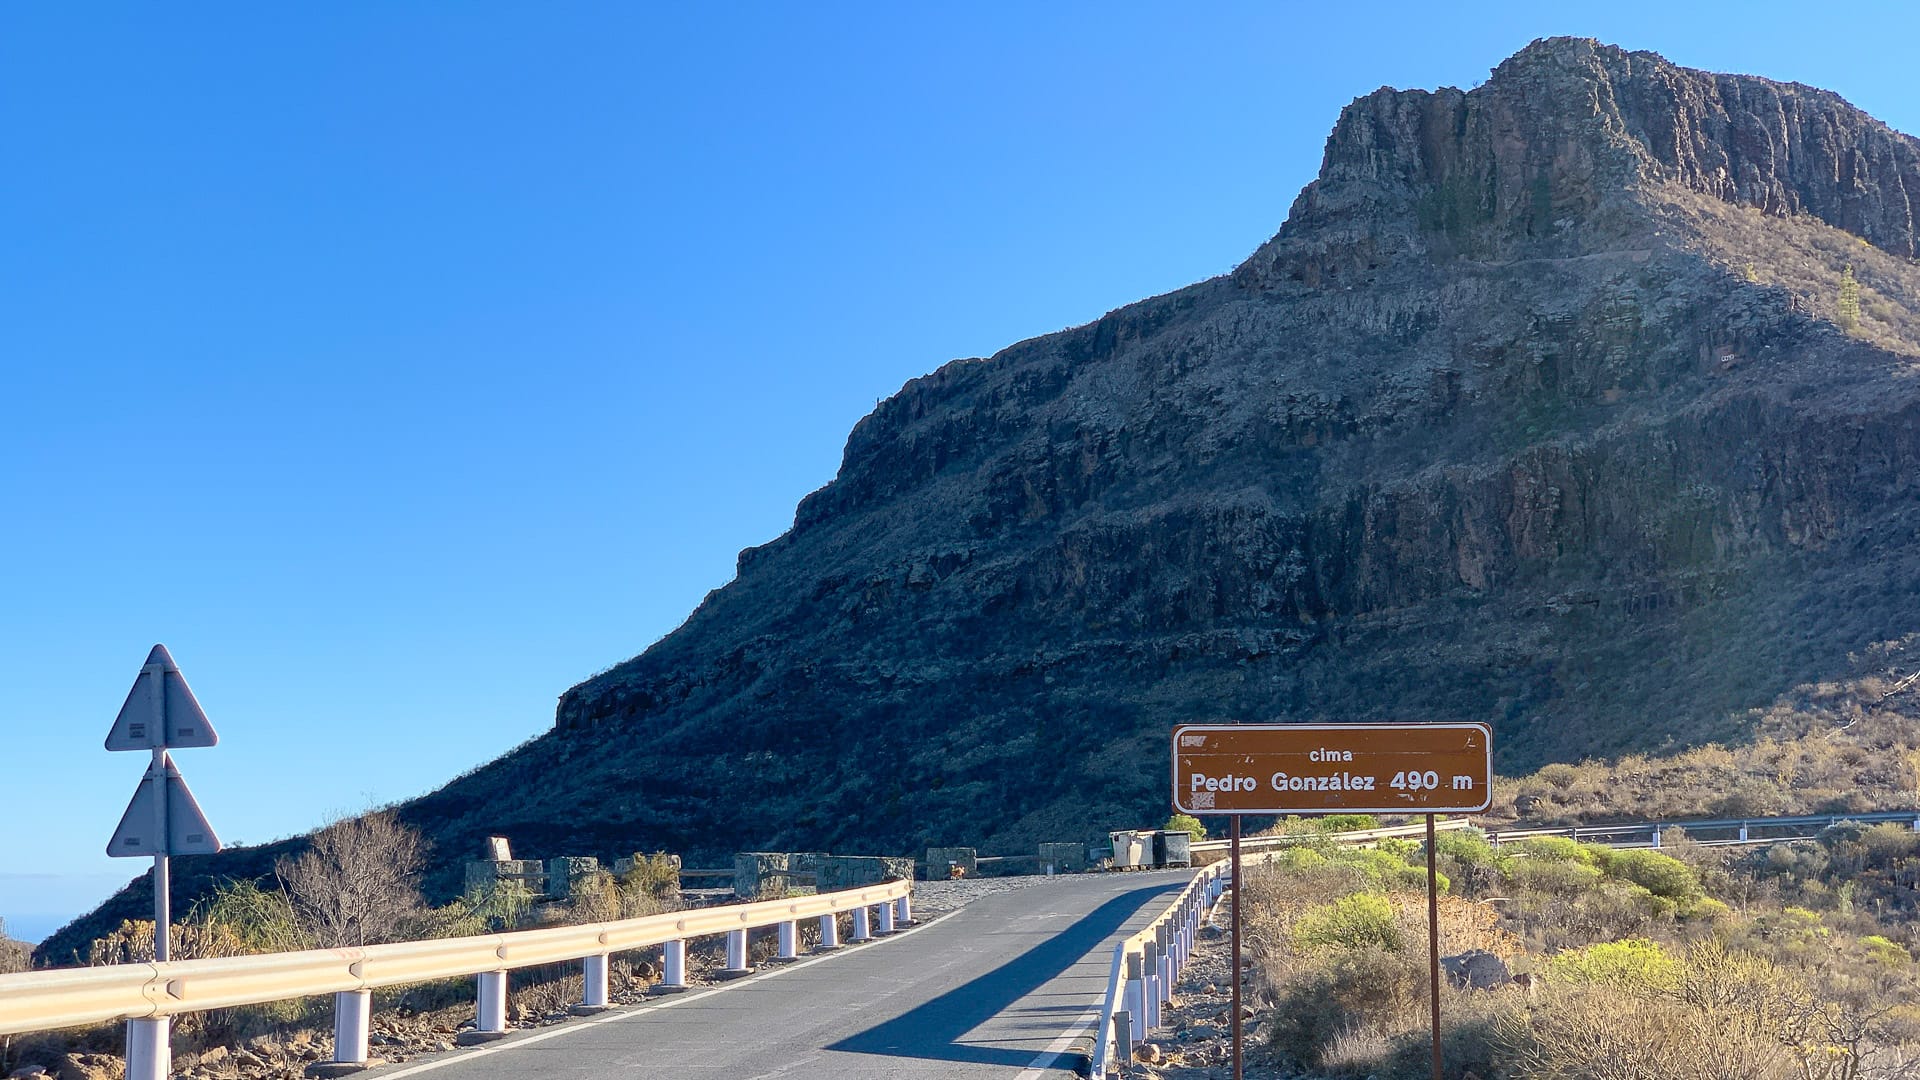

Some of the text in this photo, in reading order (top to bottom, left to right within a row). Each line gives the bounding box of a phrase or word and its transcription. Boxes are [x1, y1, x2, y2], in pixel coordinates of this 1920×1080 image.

[1309, 748, 1353, 762] cima
[1191, 771, 1473, 792] Pedro González 490 m
